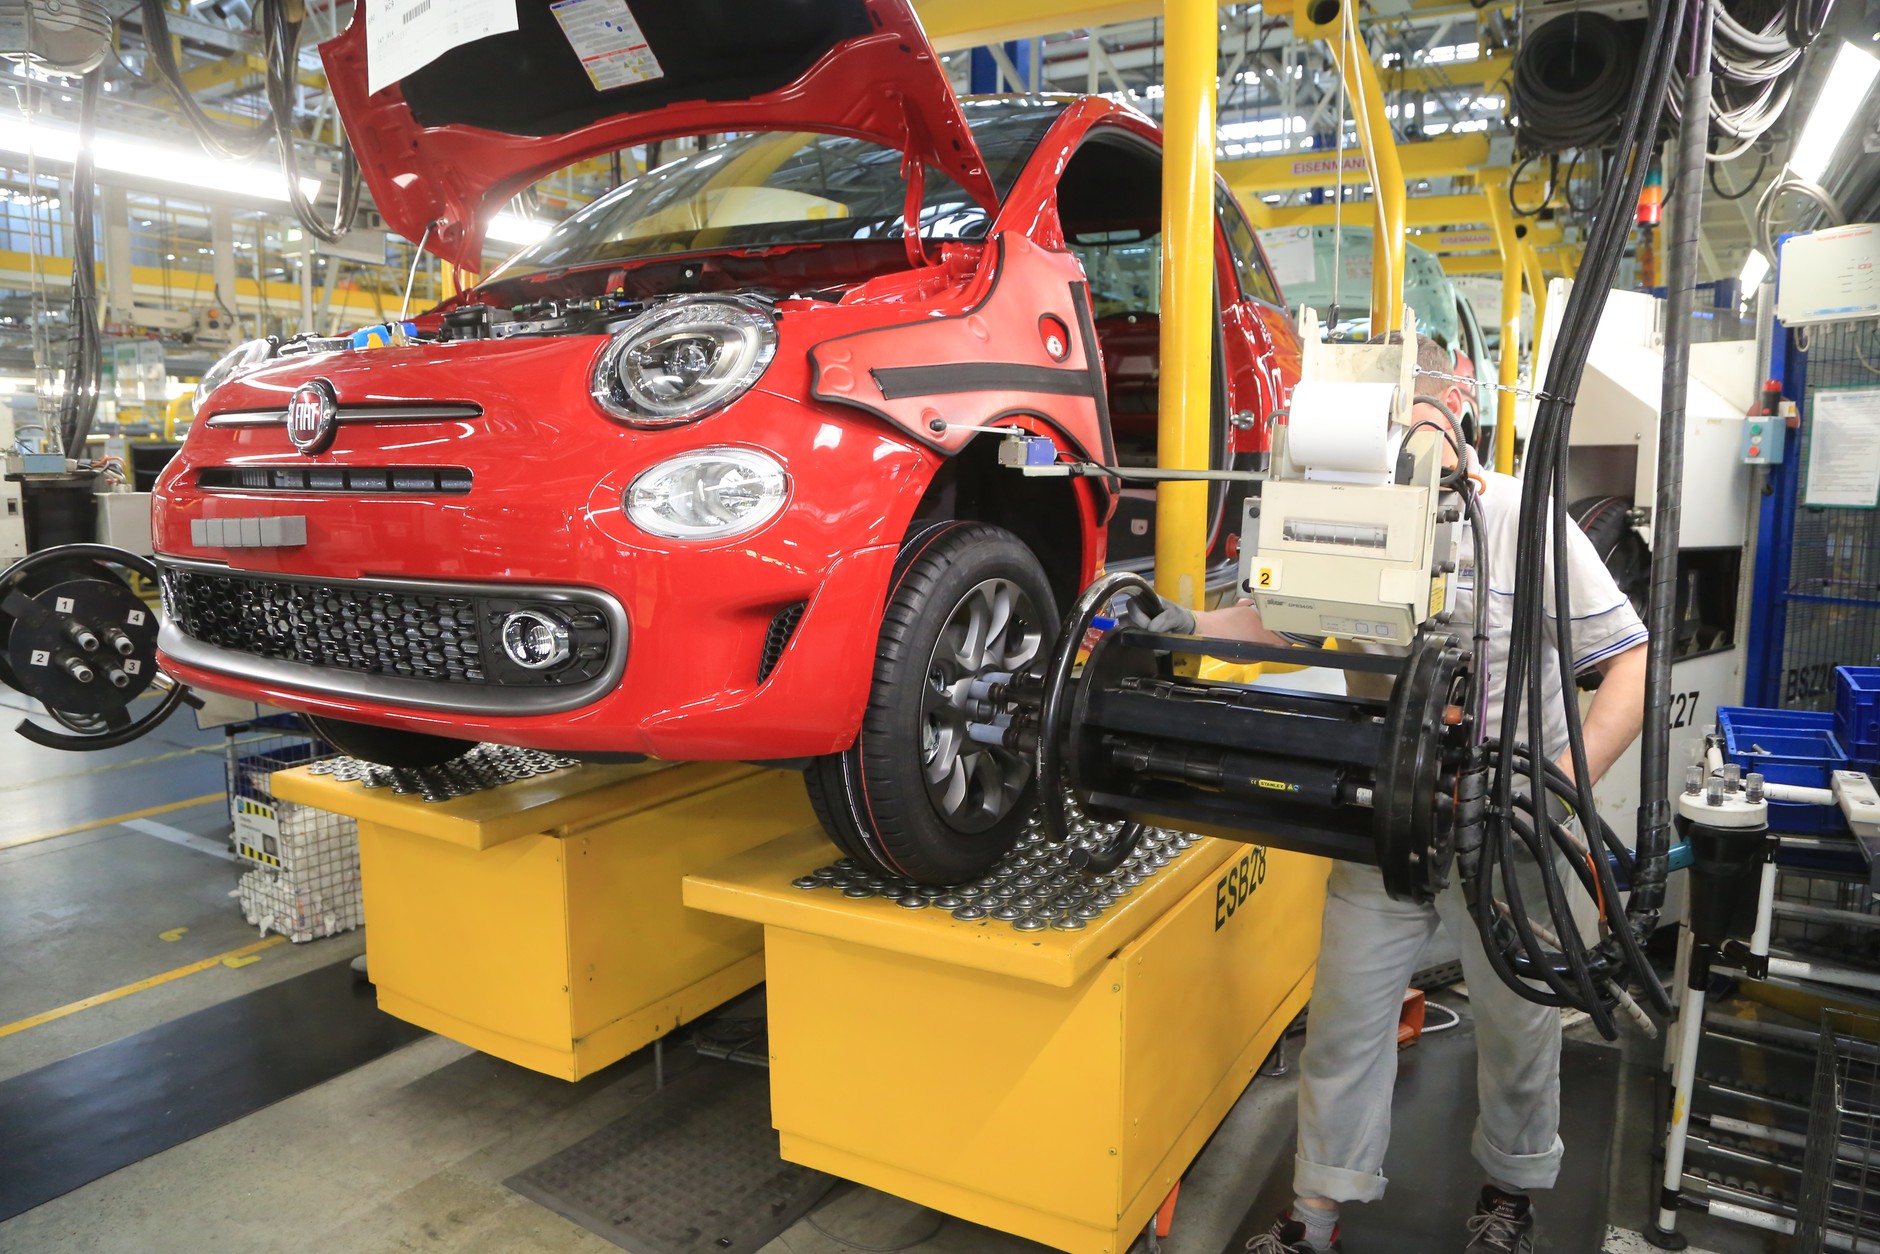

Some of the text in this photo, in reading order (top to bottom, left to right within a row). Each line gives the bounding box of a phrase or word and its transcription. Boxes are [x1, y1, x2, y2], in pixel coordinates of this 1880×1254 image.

[1440, 234, 1491, 245] EISENMANN
[295, 402, 320, 431] FIAT
[1260, 572, 1270, 585] 2
[62, 601, 68, 610] 1
[132, 613, 140, 622] 4
[36, 653, 44, 662] 2
[128, 662, 135, 671] 3
[1260, 781, 1284, 789] STANLEY
[1215, 846, 1267, 932] ESB28
